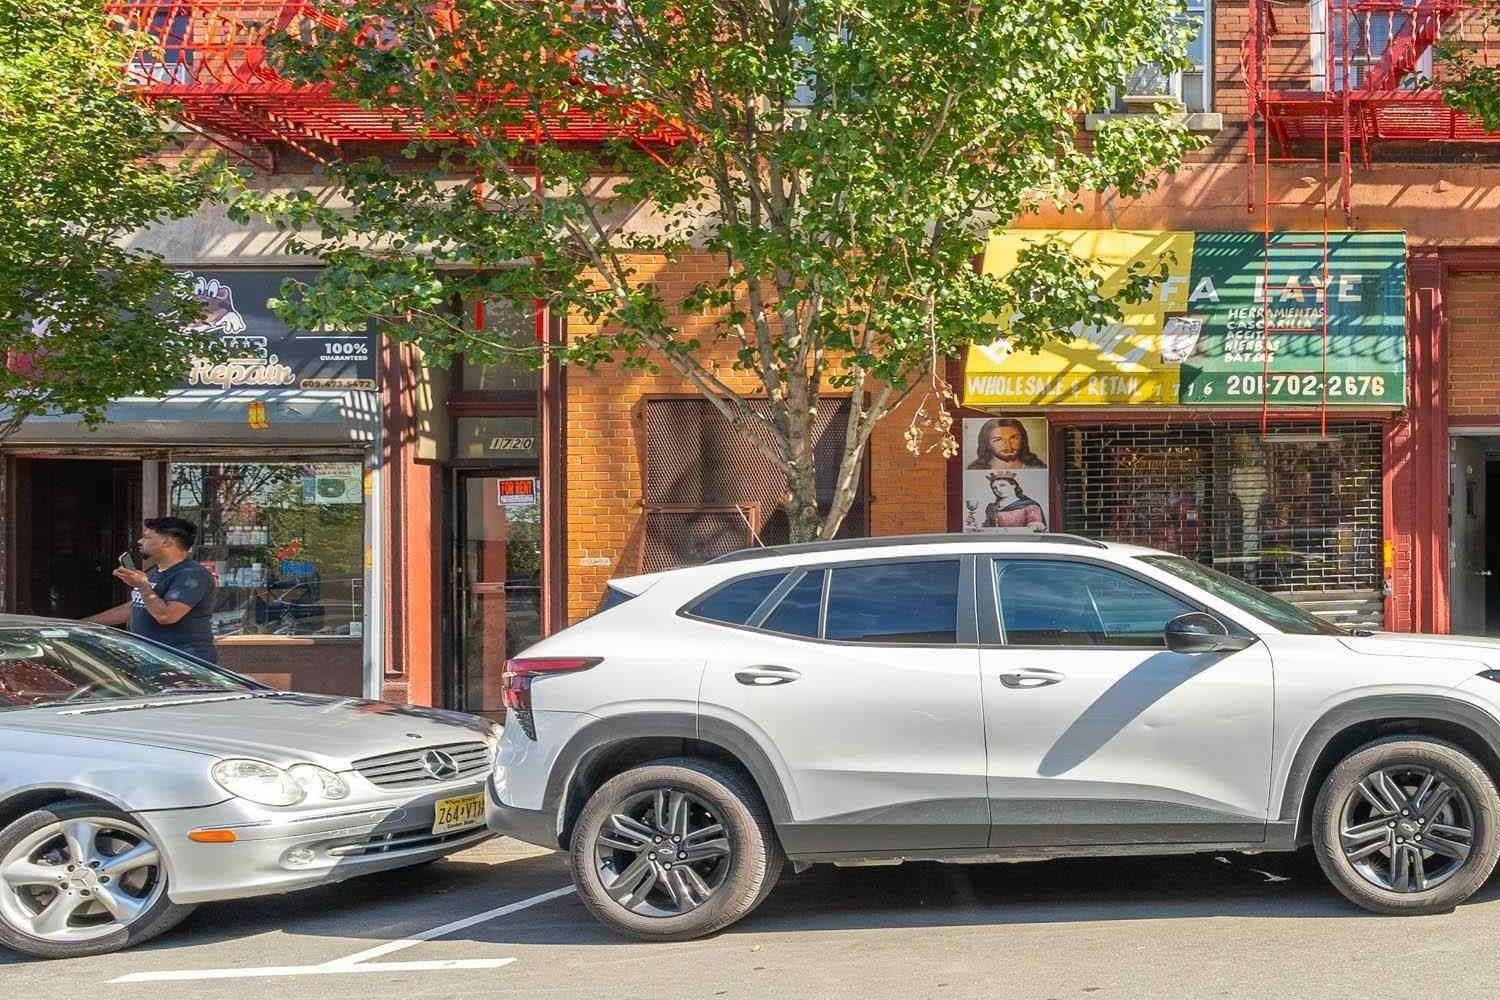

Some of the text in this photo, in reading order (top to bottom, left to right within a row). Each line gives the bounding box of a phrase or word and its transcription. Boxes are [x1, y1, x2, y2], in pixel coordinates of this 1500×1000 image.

[1253, 274, 1363, 303] LAYE
[325, 343, 368, 355] 100%
[189, 354, 296, 390] Repair
[968, 375, 1064, 396] WHOLESALE
[1087, 376, 1142, 397] RETAIL
[491, 437, 533, 450] 1720
